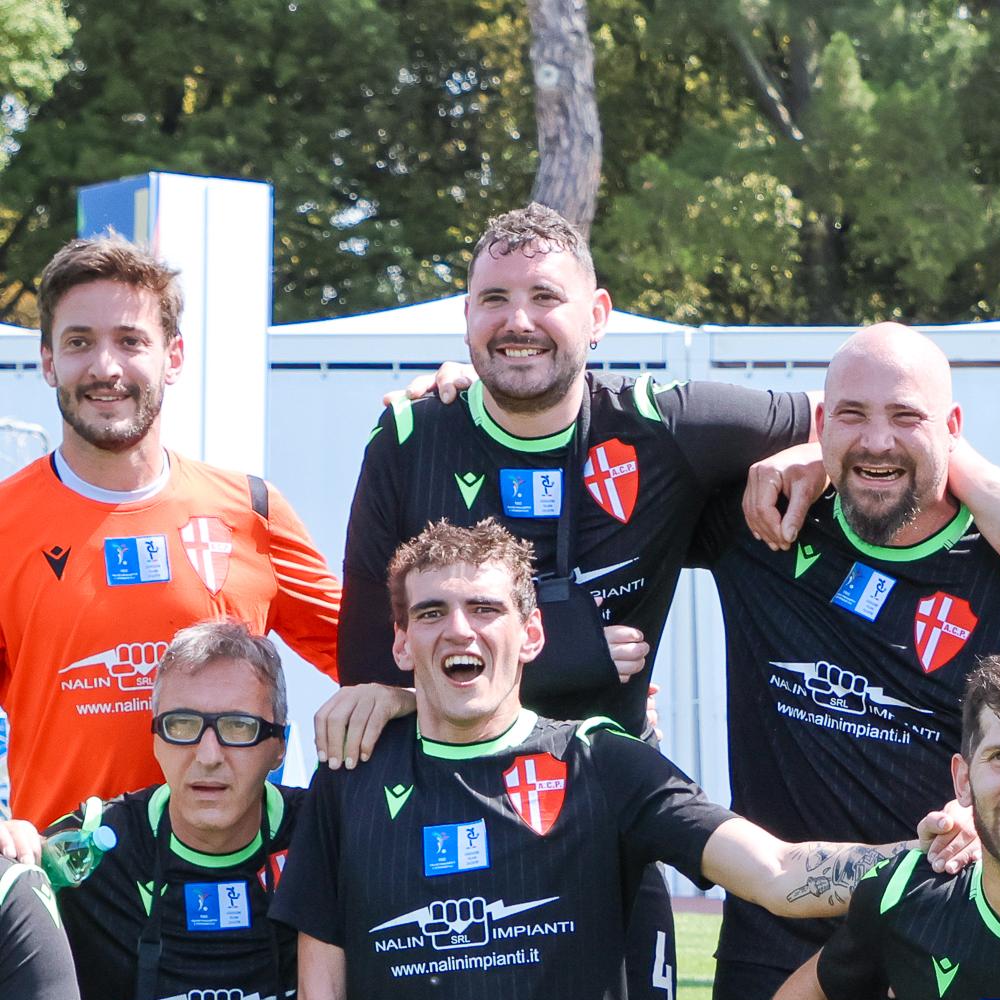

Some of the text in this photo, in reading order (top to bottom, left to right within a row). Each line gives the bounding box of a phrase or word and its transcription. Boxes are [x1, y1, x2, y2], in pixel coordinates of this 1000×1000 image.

[611, 462, 636, 477] A.C.P.
[943, 623, 967, 639] A.C.P.
[61, 677, 154, 690] NALIN SRL
[769, 675, 807, 697] NALIN
[829, 697, 849, 709] SRL
[76, 697, 152, 715] www.nalini
[777, 701, 910, 745] www.nalinimpianti.it
[538, 781, 562, 789] A.C.P.
[375, 920, 575, 953] NALIN SRL IMPIANTI
[391, 948, 540, 978] www.nalinimpianti.it
